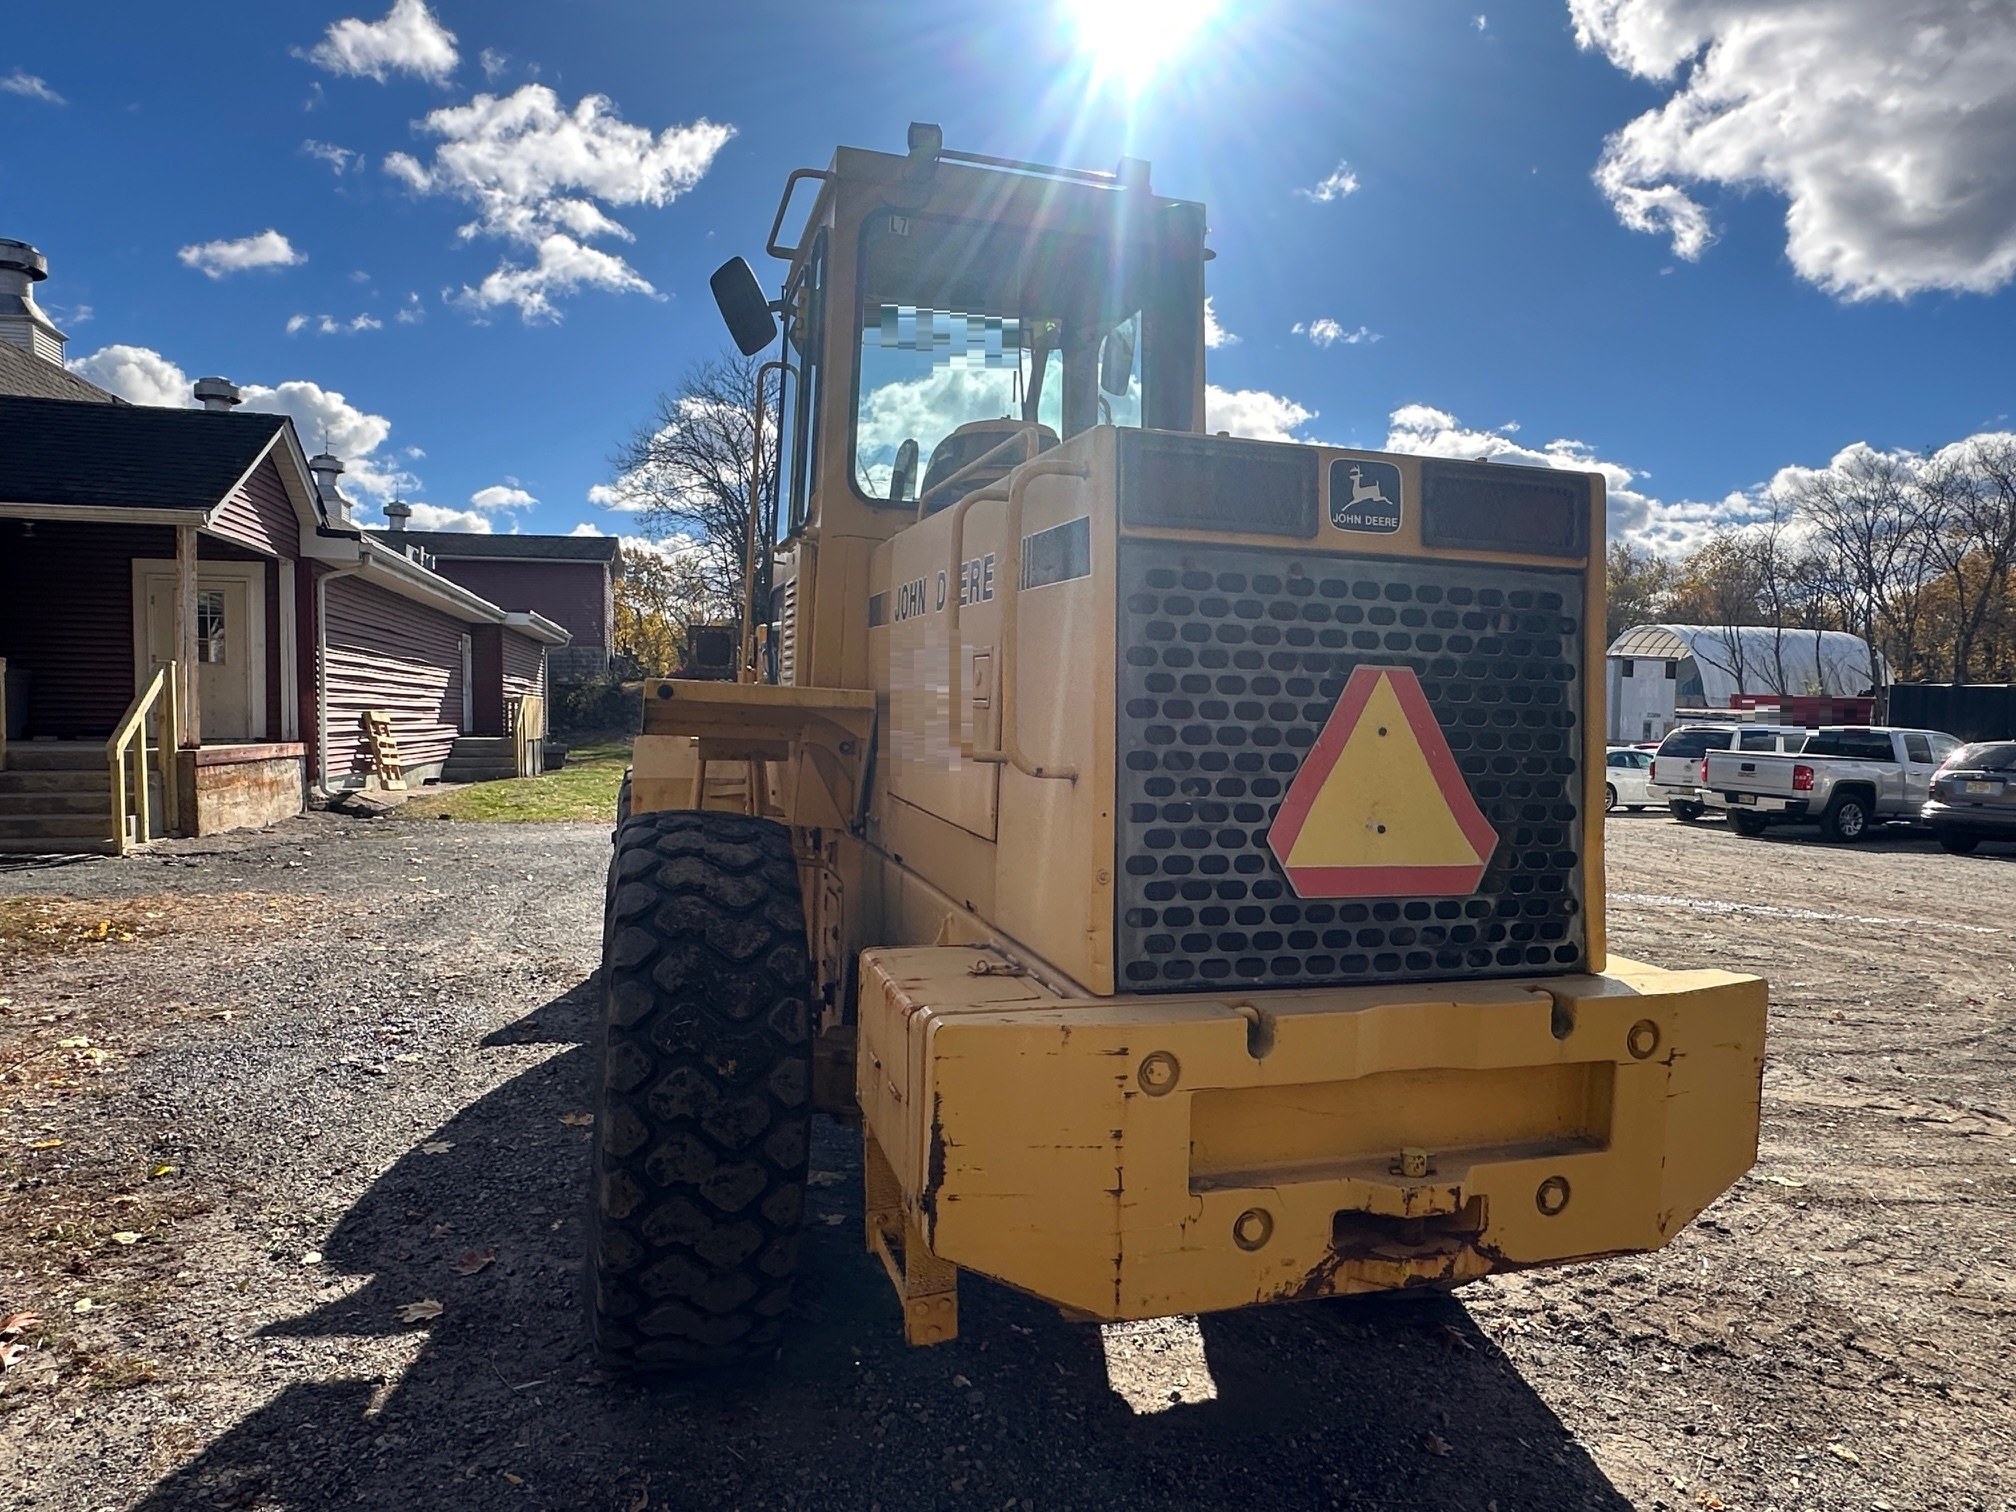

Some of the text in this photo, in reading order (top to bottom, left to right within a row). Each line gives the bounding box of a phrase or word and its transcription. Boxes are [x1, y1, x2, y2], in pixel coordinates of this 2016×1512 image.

[890, 215, 908, 234] L7
[1332, 513, 1398, 527] JOHN DEERE
[894, 552, 995, 623] JOHN DERE
